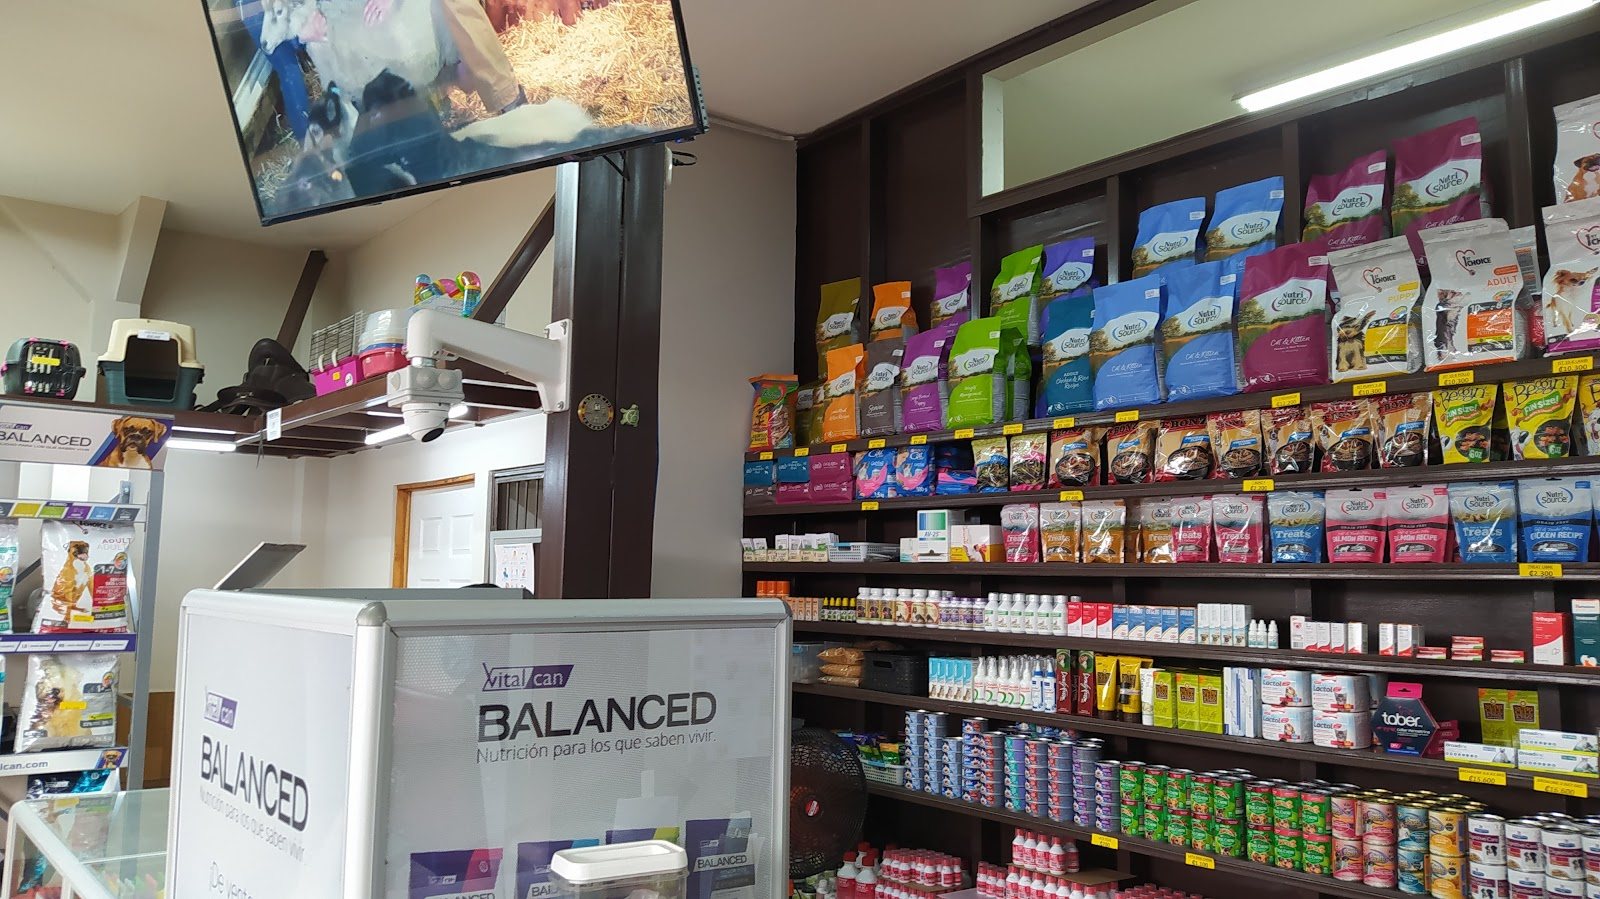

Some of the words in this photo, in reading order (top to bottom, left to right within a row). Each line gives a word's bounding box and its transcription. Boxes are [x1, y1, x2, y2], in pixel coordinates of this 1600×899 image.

[1438, 172, 1458, 184] Nutri
[1432, 179, 1464, 192] Source
[1341, 196, 1363, 204] Nutri
[1336, 201, 1366, 210] Source
[1243, 221, 1263, 230] Nutri
[1237, 226, 1264, 236] Source
[1158, 244, 1183, 253] Source
[1164, 240, 1182, 248] Nutri
[1467, 257, 1492, 266] CHOICE
[1059, 273, 1081, 282] Source
[1375, 274, 1396, 284] CHOICE
[1487, 275, 1517, 287] ADULT
[1282, 291, 1304, 300] Nutri
[1388, 292, 1415, 303] PUPPY
[1277, 296, 1308, 306] Source
[1199, 308, 1217, 317] Nutri
[1192, 315, 1219, 326] Source
[1123, 322, 1141, 331] Nutri
[1117, 327, 1142, 338] Source
[1064, 340, 1086, 349] Source
[1270, 338, 1281, 347] Cat
[1288, 335, 1311, 344] Kitten
[0, 430, 92, 447] BALANCED
[1469, 500, 1494, 508] Source
[1541, 495, 1567, 504] Source
[1405, 502, 1429, 510] Source
[1174, 532, 1202, 540] Treats
[1221, 532, 1250, 540] Treats
[1275, 530, 1311, 538] Treats
[1463, 528, 1502, 536] Treats
[1557, 531, 1584, 539] RECIPE
[1150, 533, 1172, 541] Treat
[533, 672, 564, 687] can
[1262, 679, 1282, 687] Lactol
[1313, 685, 1333, 693] Lactol
[478, 692, 718, 743] BALANCED
[1262, 716, 1282, 724] Lactol
[476, 744, 548, 765] Nutrición
[553, 741, 587, 760] para
[590, 737, 612, 753] los
[615, 736, 642, 754] que
[644, 732, 686, 749] saben
[687, 730, 717, 745] vivir.
[200, 735, 309, 832] BALANCED
[697, 855, 748, 869] BALANCED
